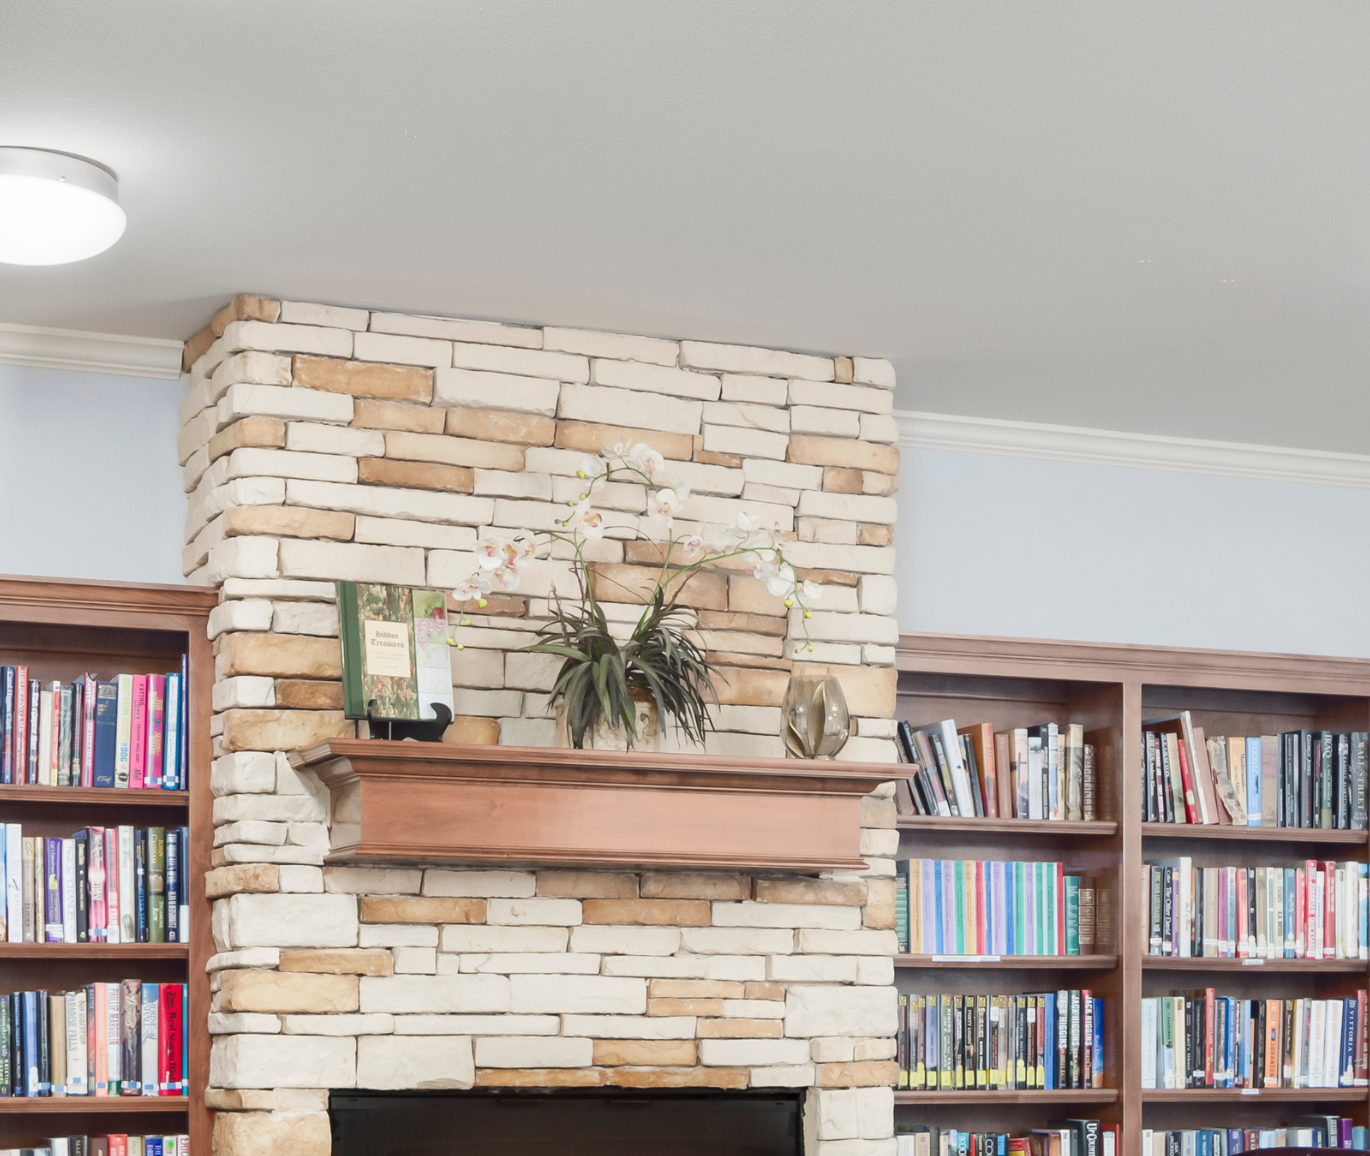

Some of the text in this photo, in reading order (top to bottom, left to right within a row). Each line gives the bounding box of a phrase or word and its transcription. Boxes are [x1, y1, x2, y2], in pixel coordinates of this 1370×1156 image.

[370, 638, 405, 648] Treasures
[375, 630, 399, 639] Hidden
[1357, 741, 1365, 811] WALL STREET
[1085, 994, 1093, 1046] JACK HIGGINS
